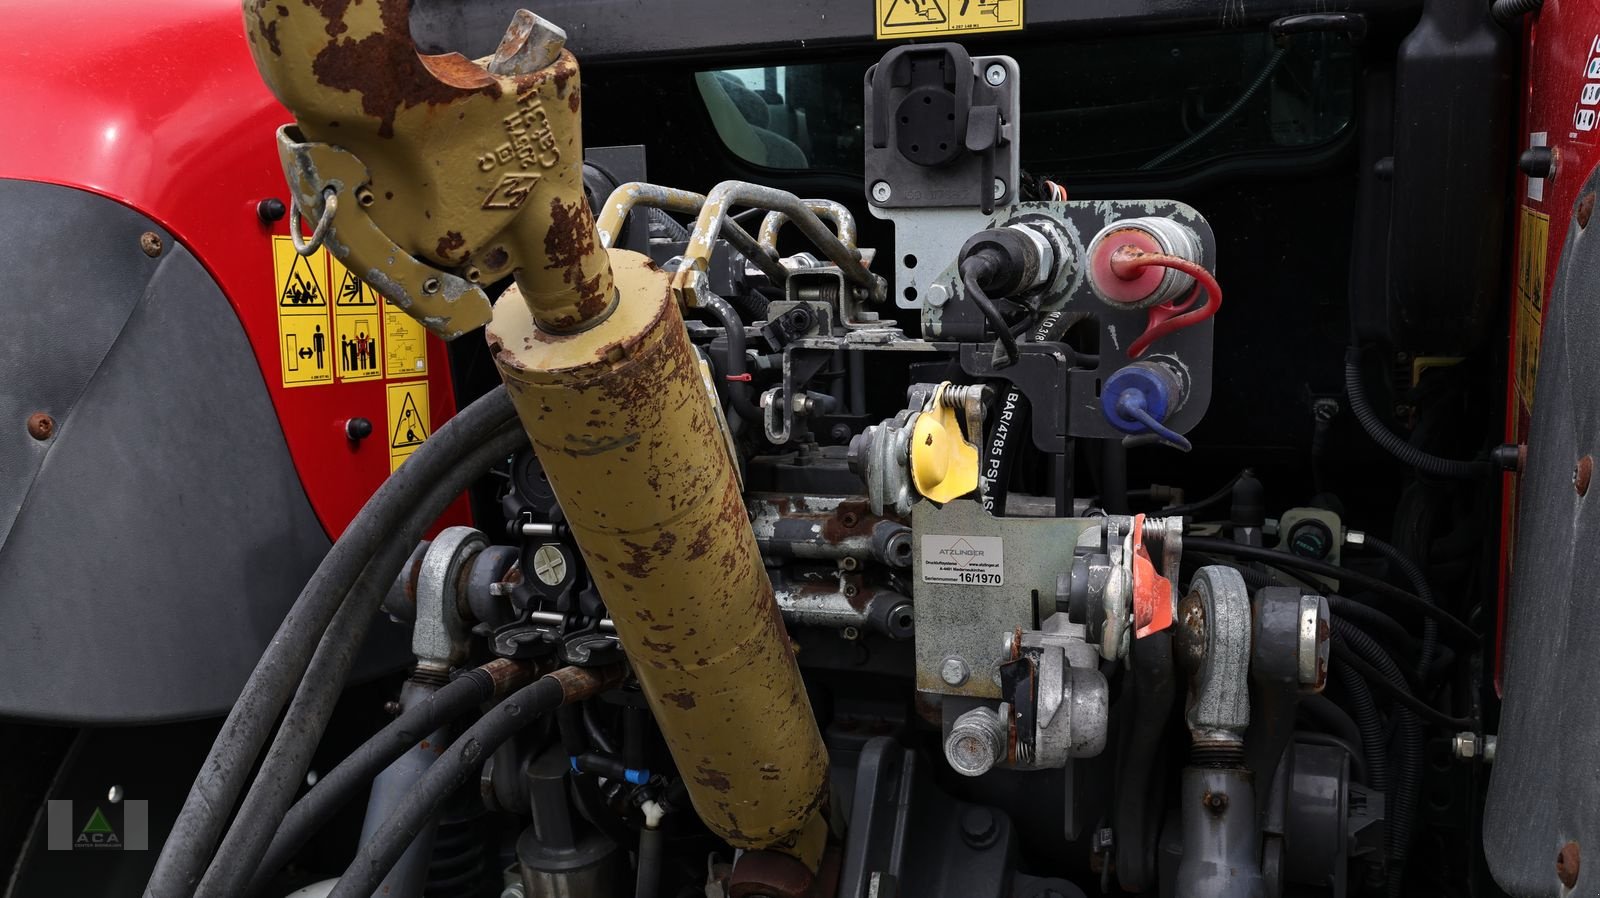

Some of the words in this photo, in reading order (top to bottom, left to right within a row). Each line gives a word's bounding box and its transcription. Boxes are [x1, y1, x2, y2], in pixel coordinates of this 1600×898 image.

[991, 392, 1019, 456] BAR/4785
[986, 458, 1001, 483] PSI
[959, 573, 1001, 584] 16/1970
